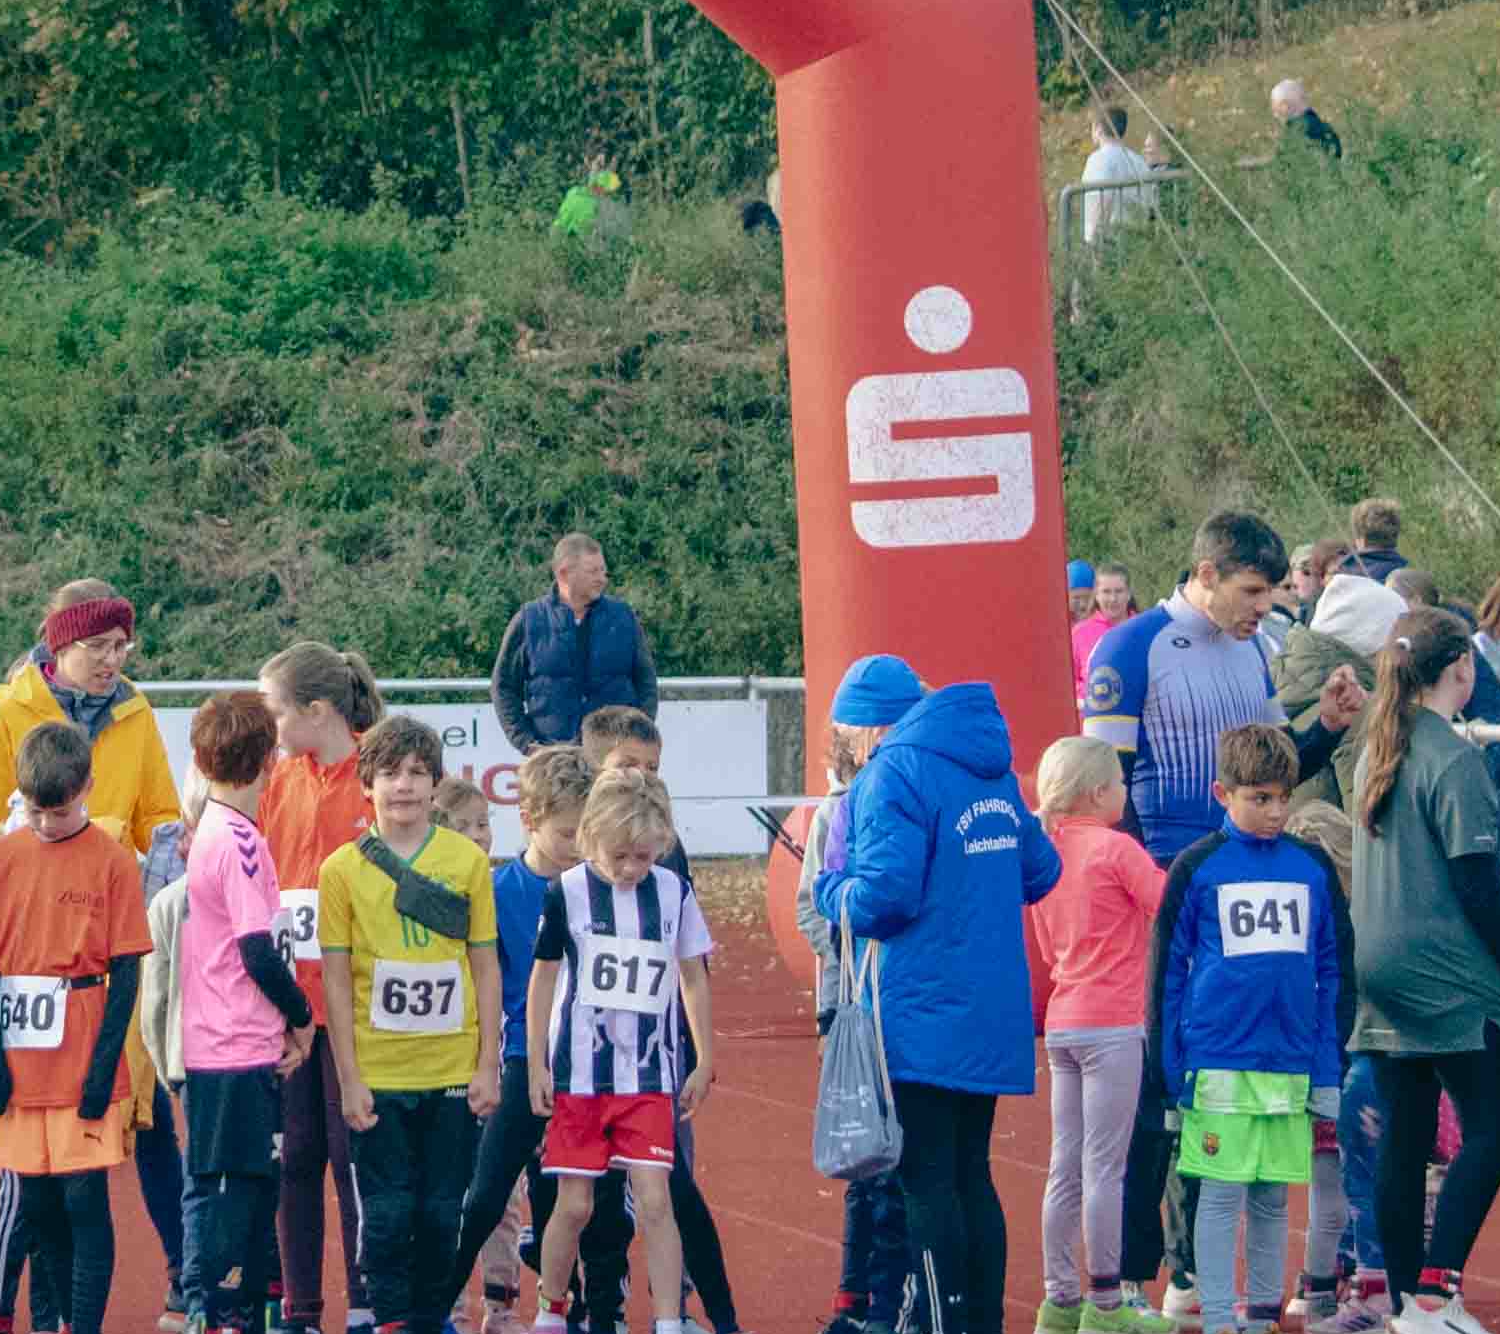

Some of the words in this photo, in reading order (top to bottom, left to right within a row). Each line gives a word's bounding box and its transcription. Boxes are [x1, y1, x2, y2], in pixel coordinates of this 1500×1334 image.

[1230, 898, 1301, 938] 641
[592, 952, 667, 996] 617
[0, 992, 56, 1032] 640
[382, 977, 457, 1016] 637
